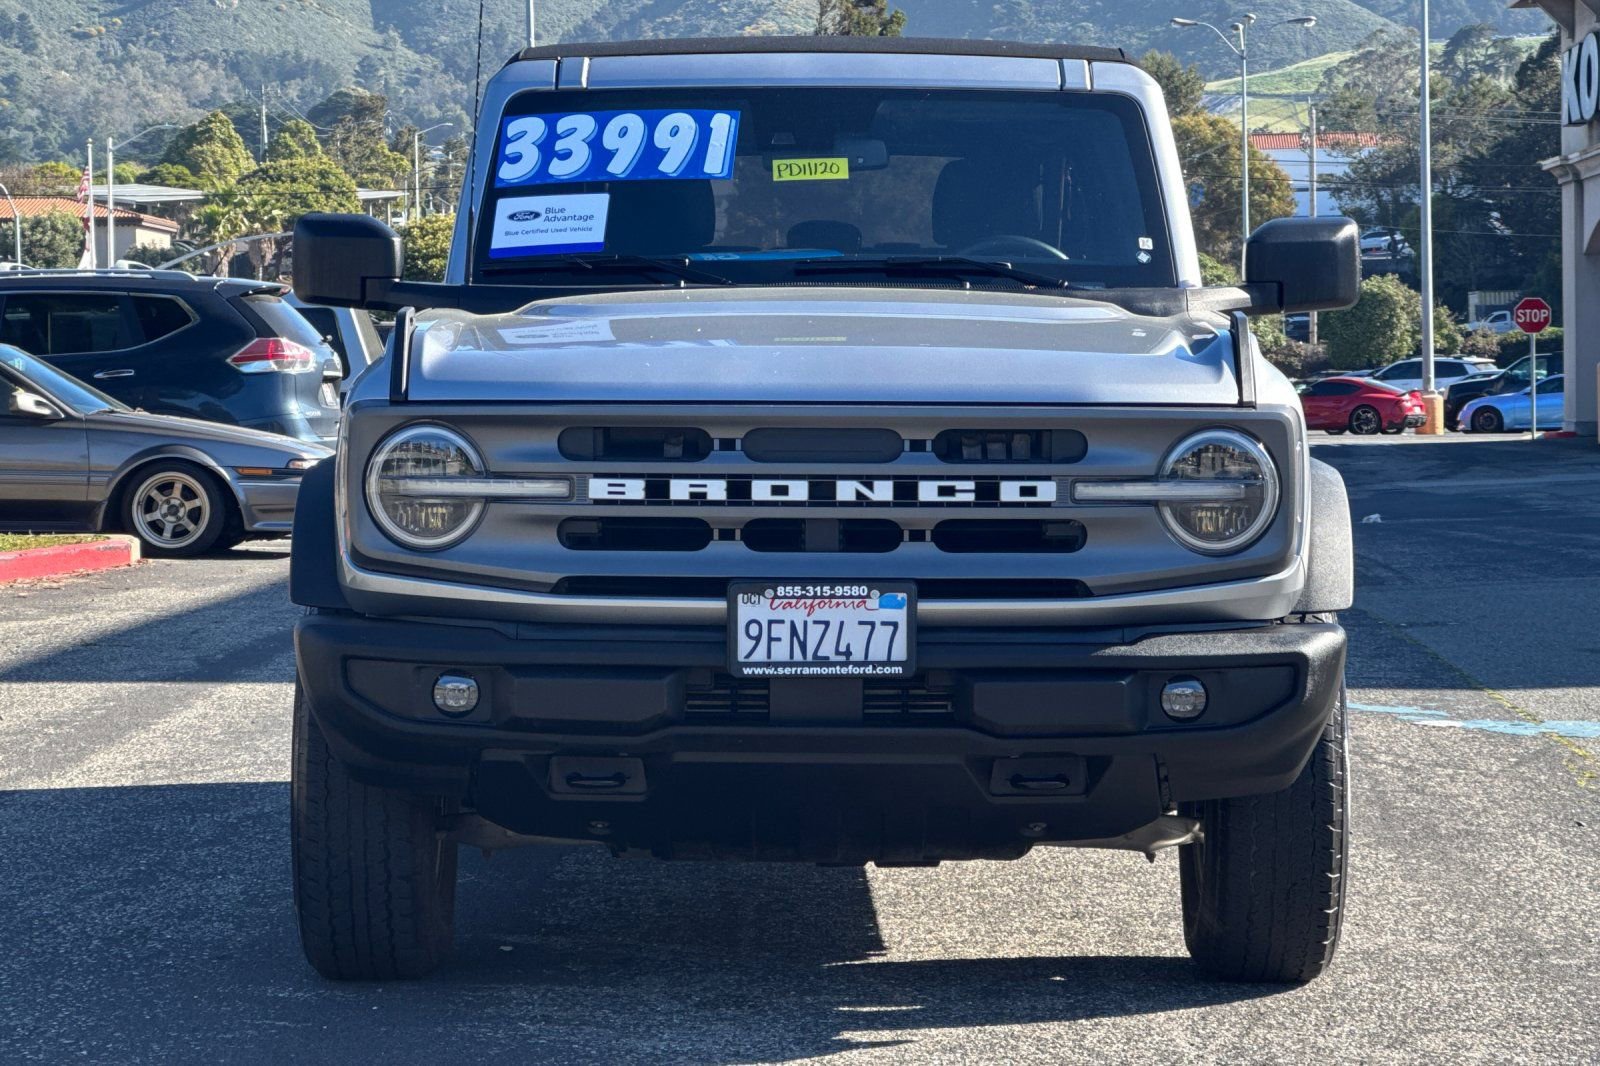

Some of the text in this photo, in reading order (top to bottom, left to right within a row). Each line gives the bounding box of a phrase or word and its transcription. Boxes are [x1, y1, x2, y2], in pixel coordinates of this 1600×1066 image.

[498, 112, 735, 181] 33991
[513, 211, 535, 220] Ford
[544, 214, 594, 222] Advantage
[521, 227, 548, 235] Certified
[1516, 309, 1549, 323] STOP
[588, 477, 1057, 502] BRONCO
[776, 586, 868, 597] 855-315-9580
[769, 597, 879, 617] California
[743, 618, 899, 662] 9FNZ477
[742, 664, 903, 675] www.serramonteford.com
